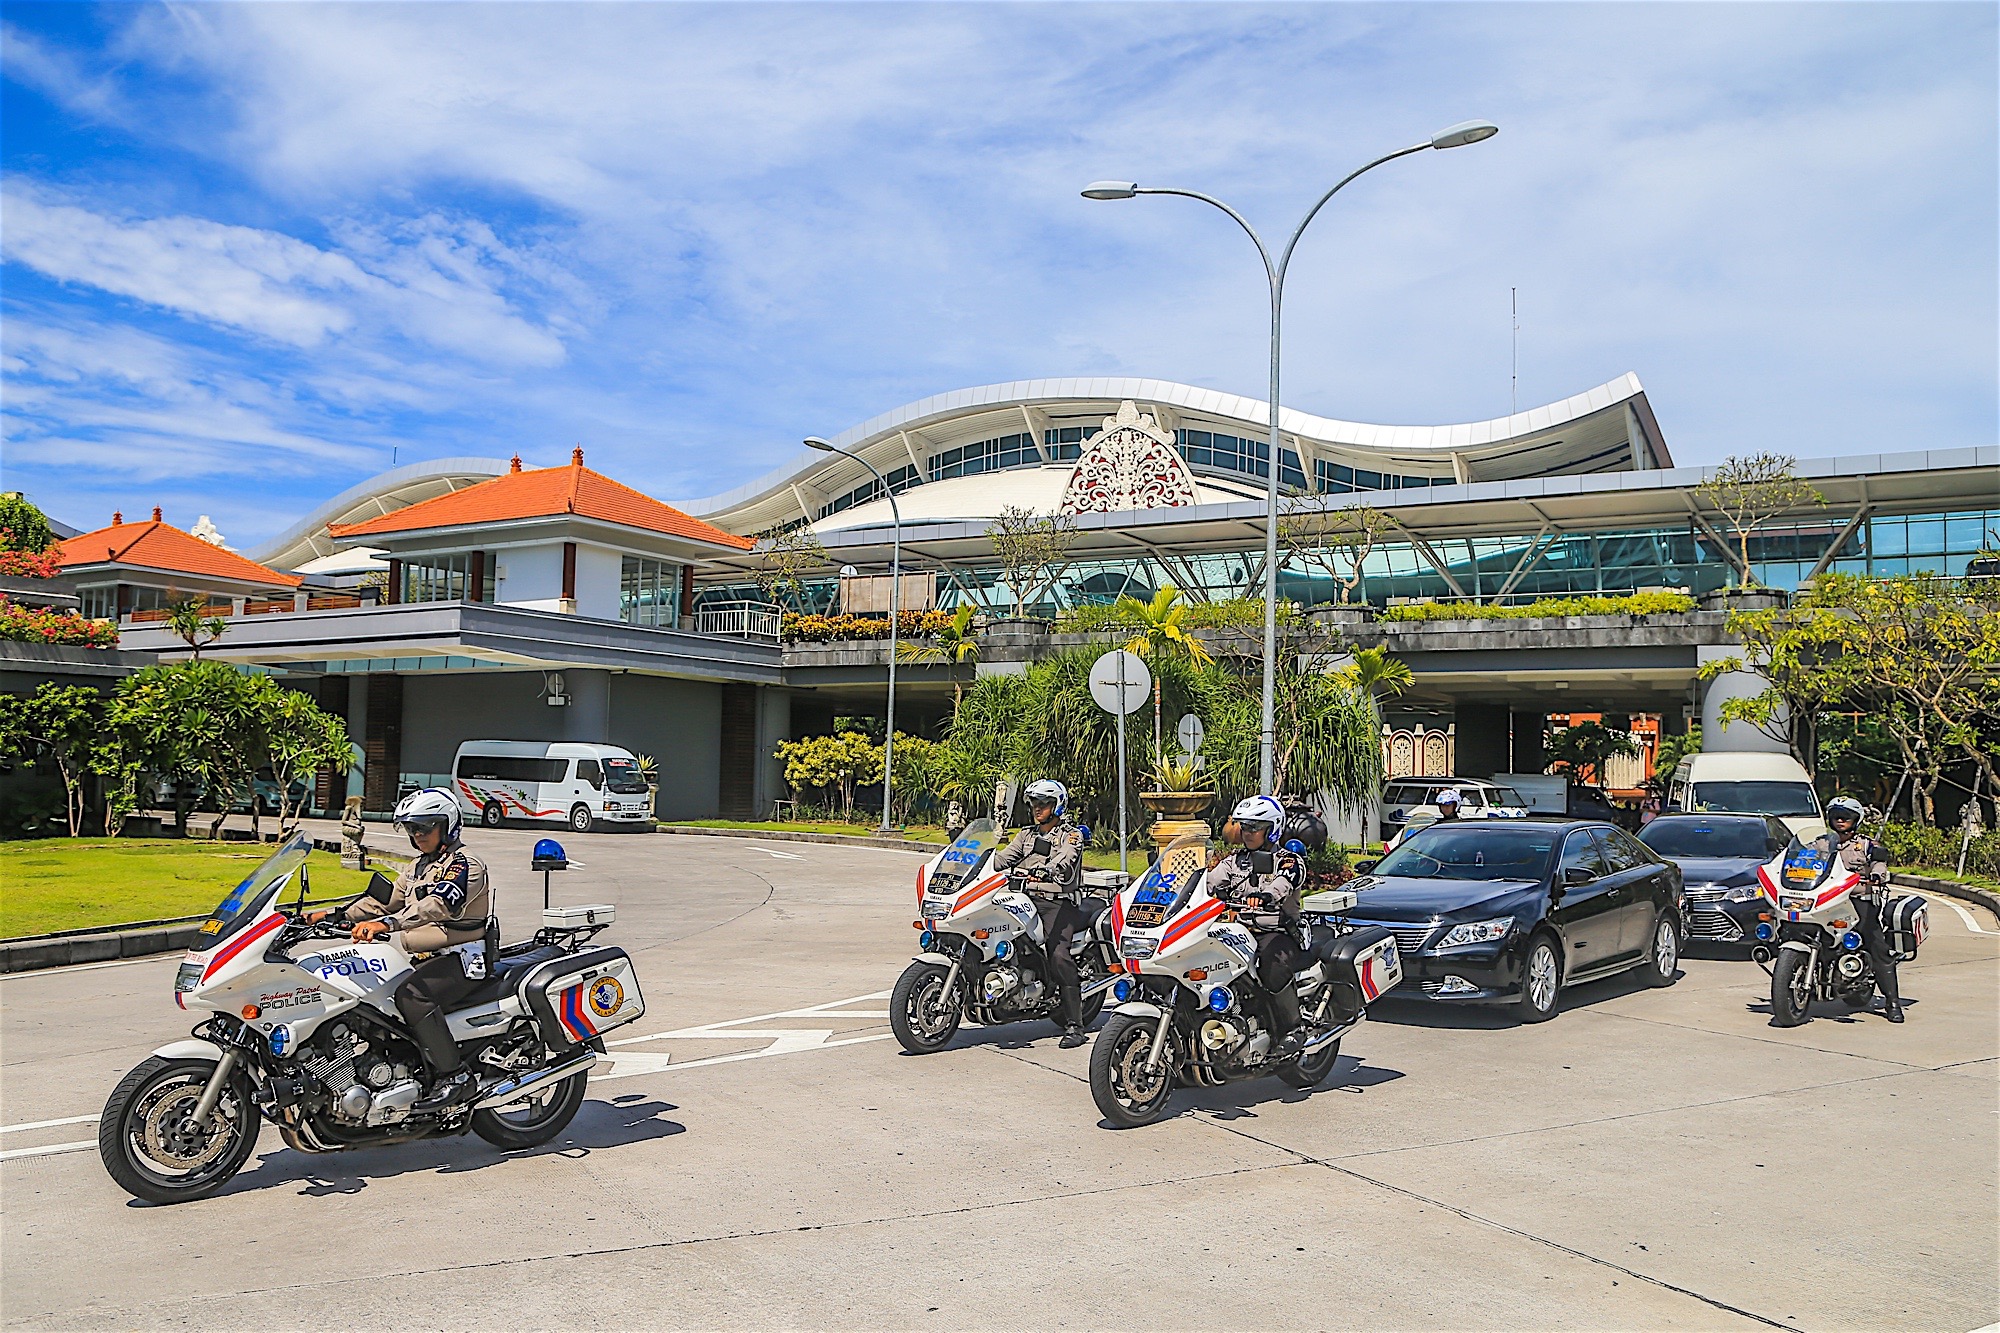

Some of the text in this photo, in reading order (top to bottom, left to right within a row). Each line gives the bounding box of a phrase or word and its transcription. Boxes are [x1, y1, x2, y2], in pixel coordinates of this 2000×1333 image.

[955, 839, 982, 850] 02
[944, 850, 981, 866] POLISI
[1147, 872, 1177, 890] 02
[1135, 889, 1179, 905] POLISI
[1004, 902, 1033, 915] POLISI
[319, 948, 360, 963] YAMAHA
[321, 958, 388, 980] POLISI
[592, 978, 616, 992] PATROLI
[260, 984, 321, 1003] Highway Patrol
[259, 993, 322, 1013] POLICE
